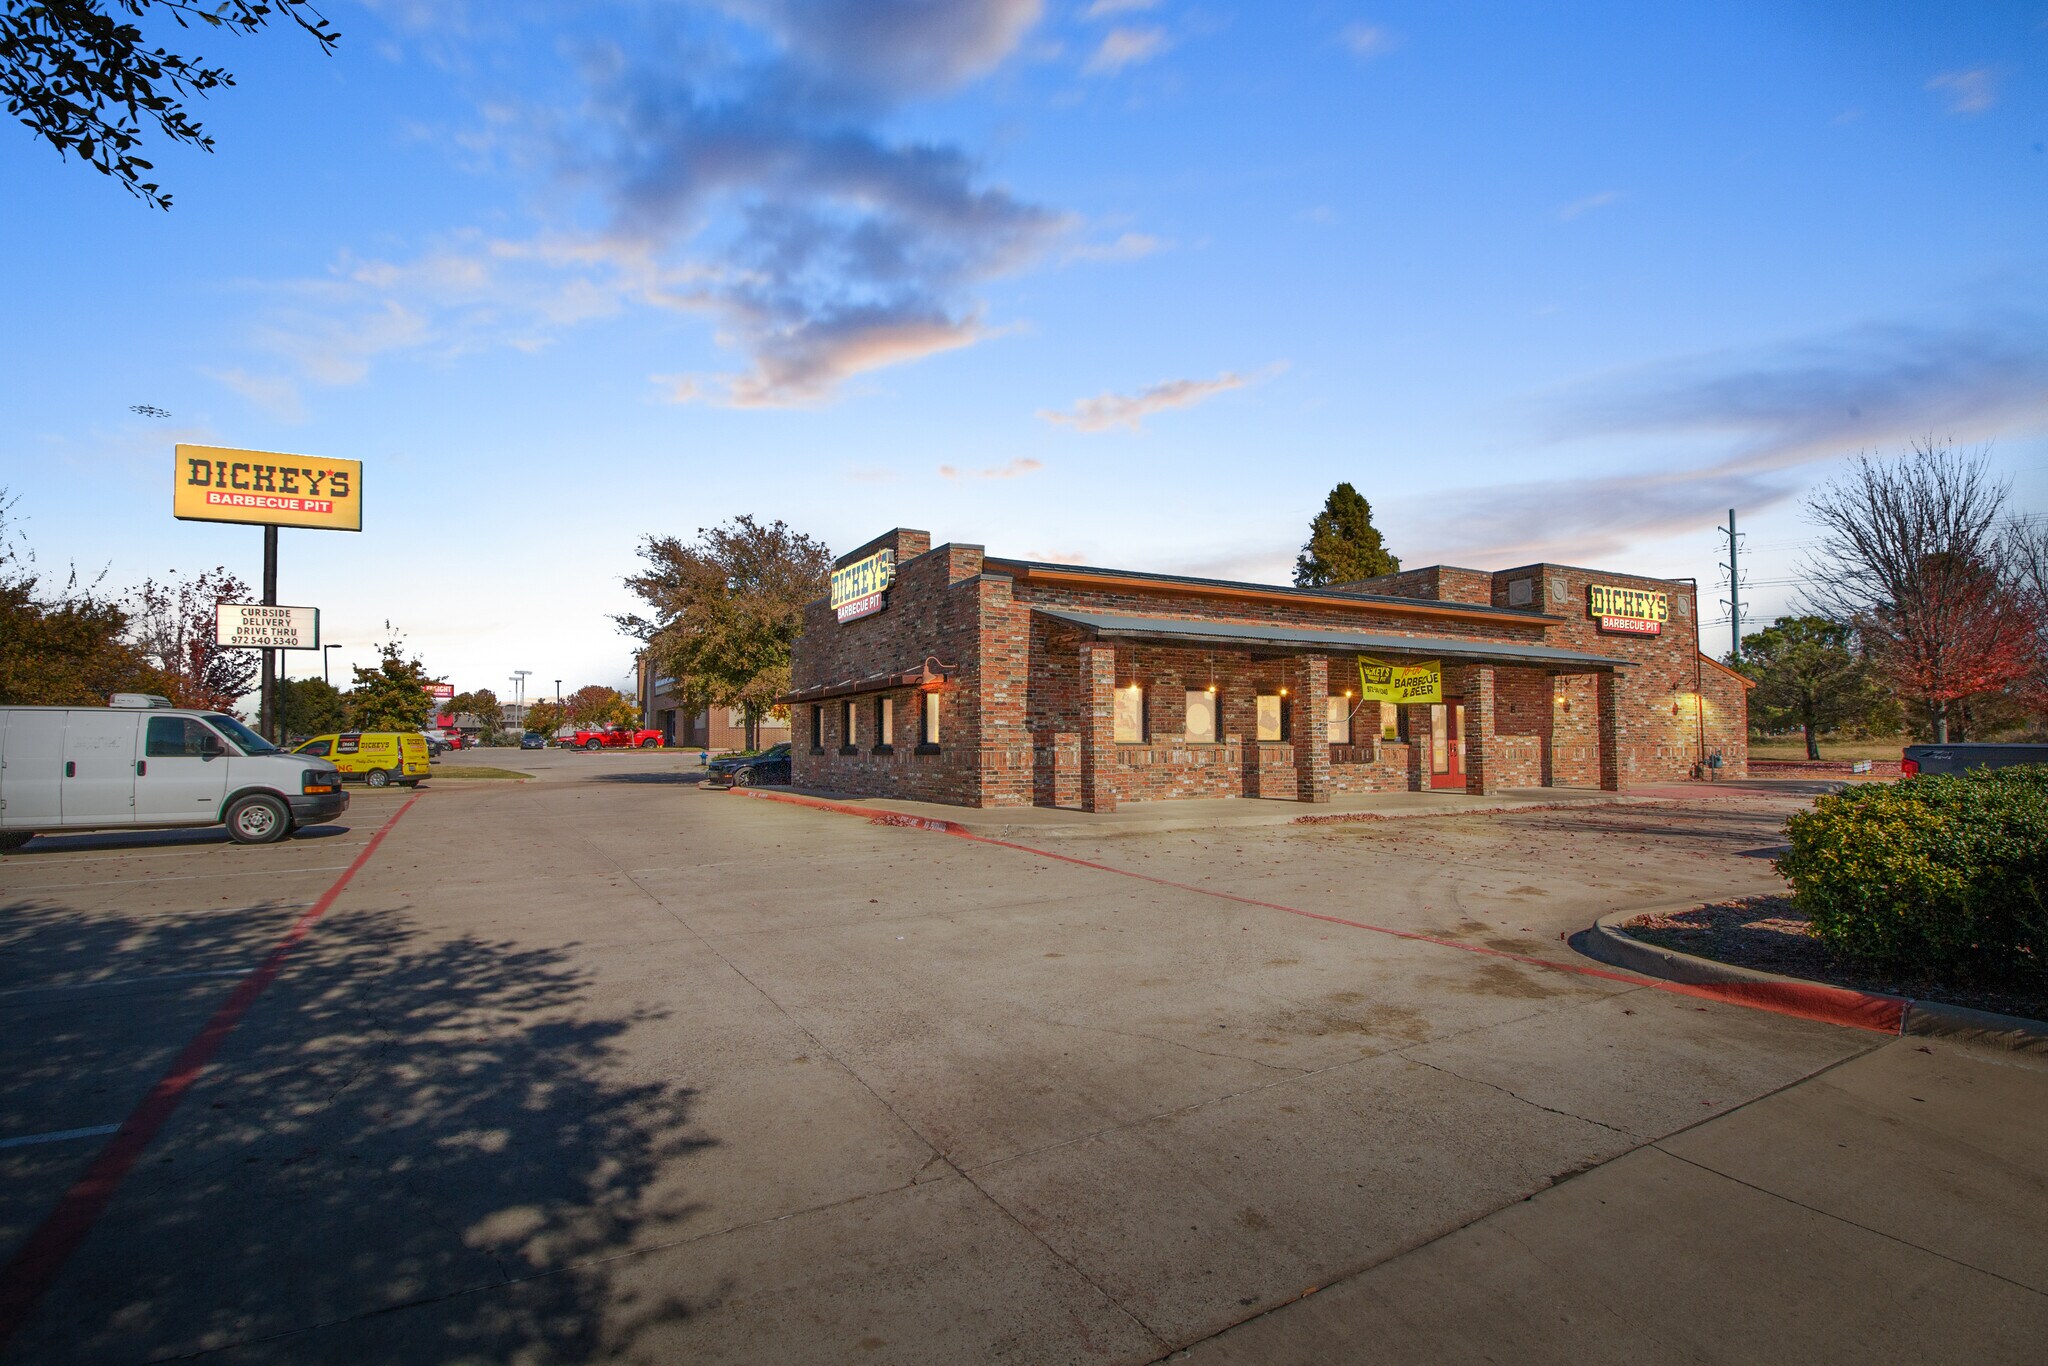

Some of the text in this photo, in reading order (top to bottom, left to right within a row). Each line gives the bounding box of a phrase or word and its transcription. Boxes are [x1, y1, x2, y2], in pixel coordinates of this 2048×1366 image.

[187, 458, 350, 498] DICKEY'S
[209, 493, 330, 512] BARBECUE PIT
[831, 552, 889, 606] DICKEY'S
[837, 594, 880, 620] BARBECUE PIT
[1592, 587, 1668, 620] DICKEY'S
[241, 608, 291, 618] CURBSIDE
[243, 617, 291, 627] DELIVERY
[1603, 617, 1658, 632] BARBECUE PIT
[236, 626, 297, 636] DRIVE THRU
[231, 636, 298, 646] 972 540 5340
[1394, 673, 1439, 689] BARBECUE
[1402, 685, 1434, 698] & BEER
